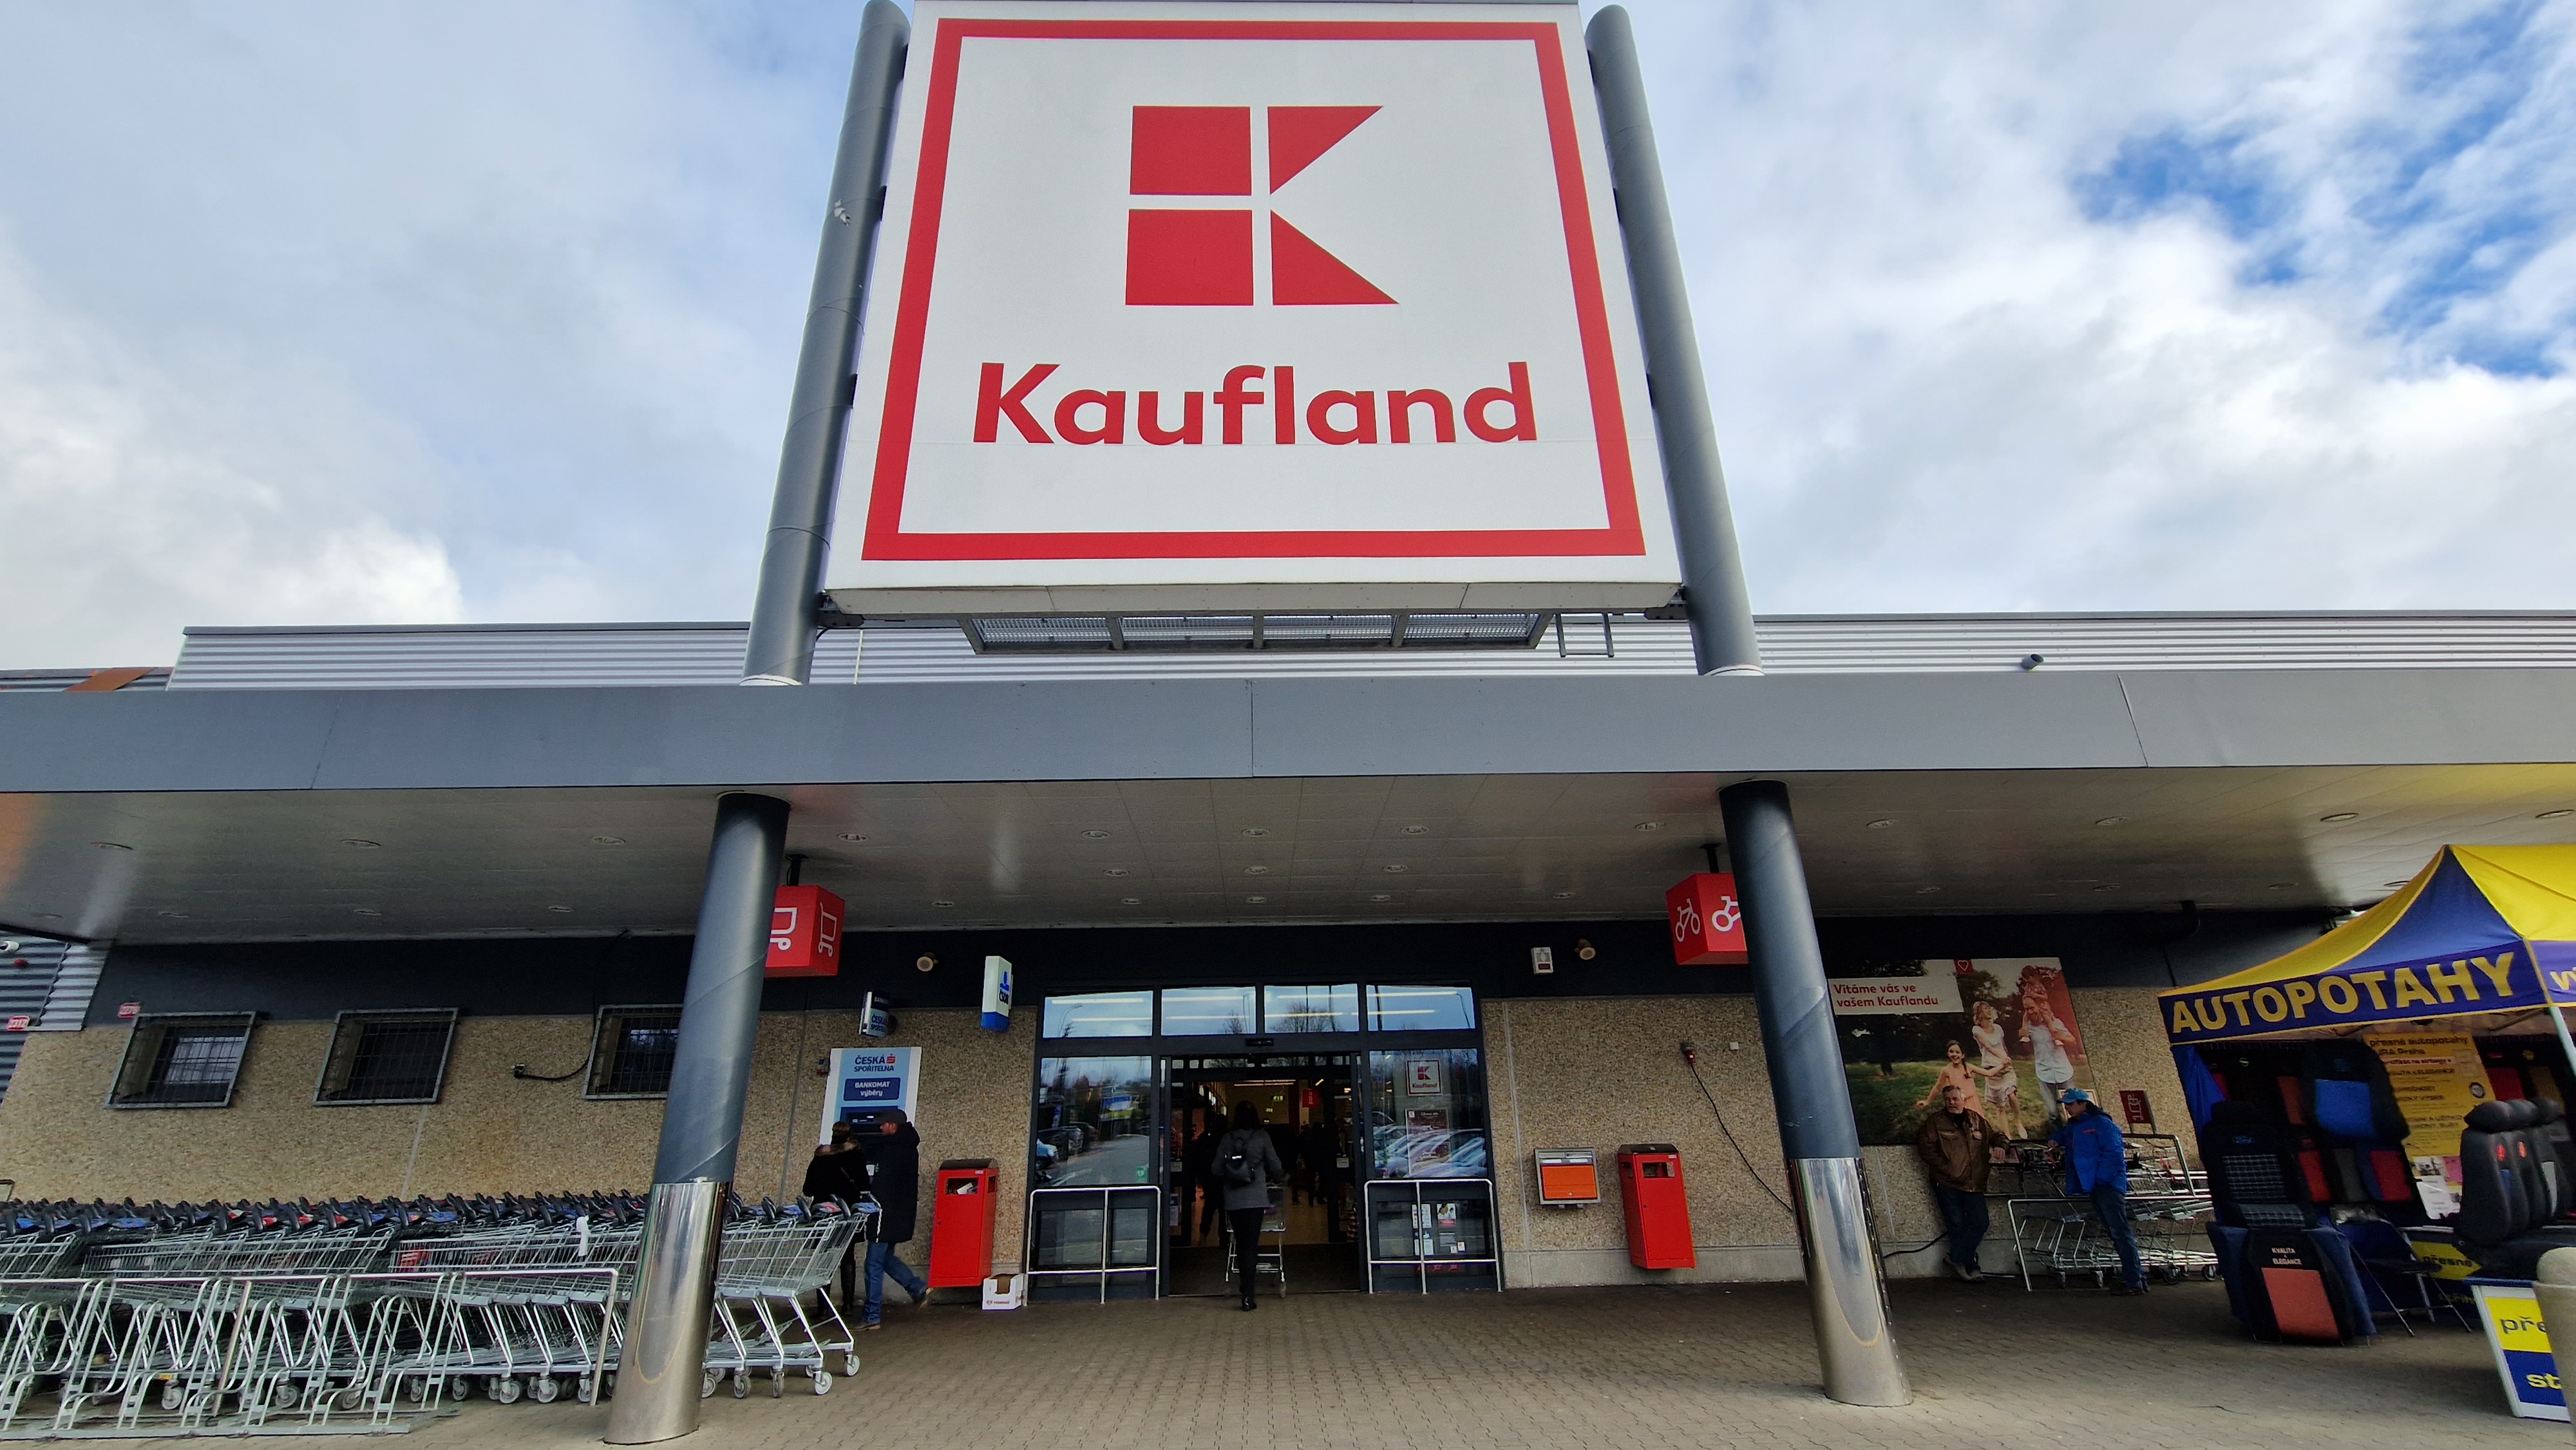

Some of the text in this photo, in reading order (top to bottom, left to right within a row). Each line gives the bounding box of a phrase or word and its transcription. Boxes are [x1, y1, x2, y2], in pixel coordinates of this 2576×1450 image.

[973, 361, 1538, 445] Kaufland
[1833, 984, 1877, 994] Vítáme
[1880, 984, 1900, 993] vás
[2172, 952, 2515, 1034] AUTOPOTAHY
[1837, 995, 1938, 1007] vašem Kauflandu
[855, 1054, 886, 1065] ČESKÁ
[860, 1089, 884, 1097] výběry
